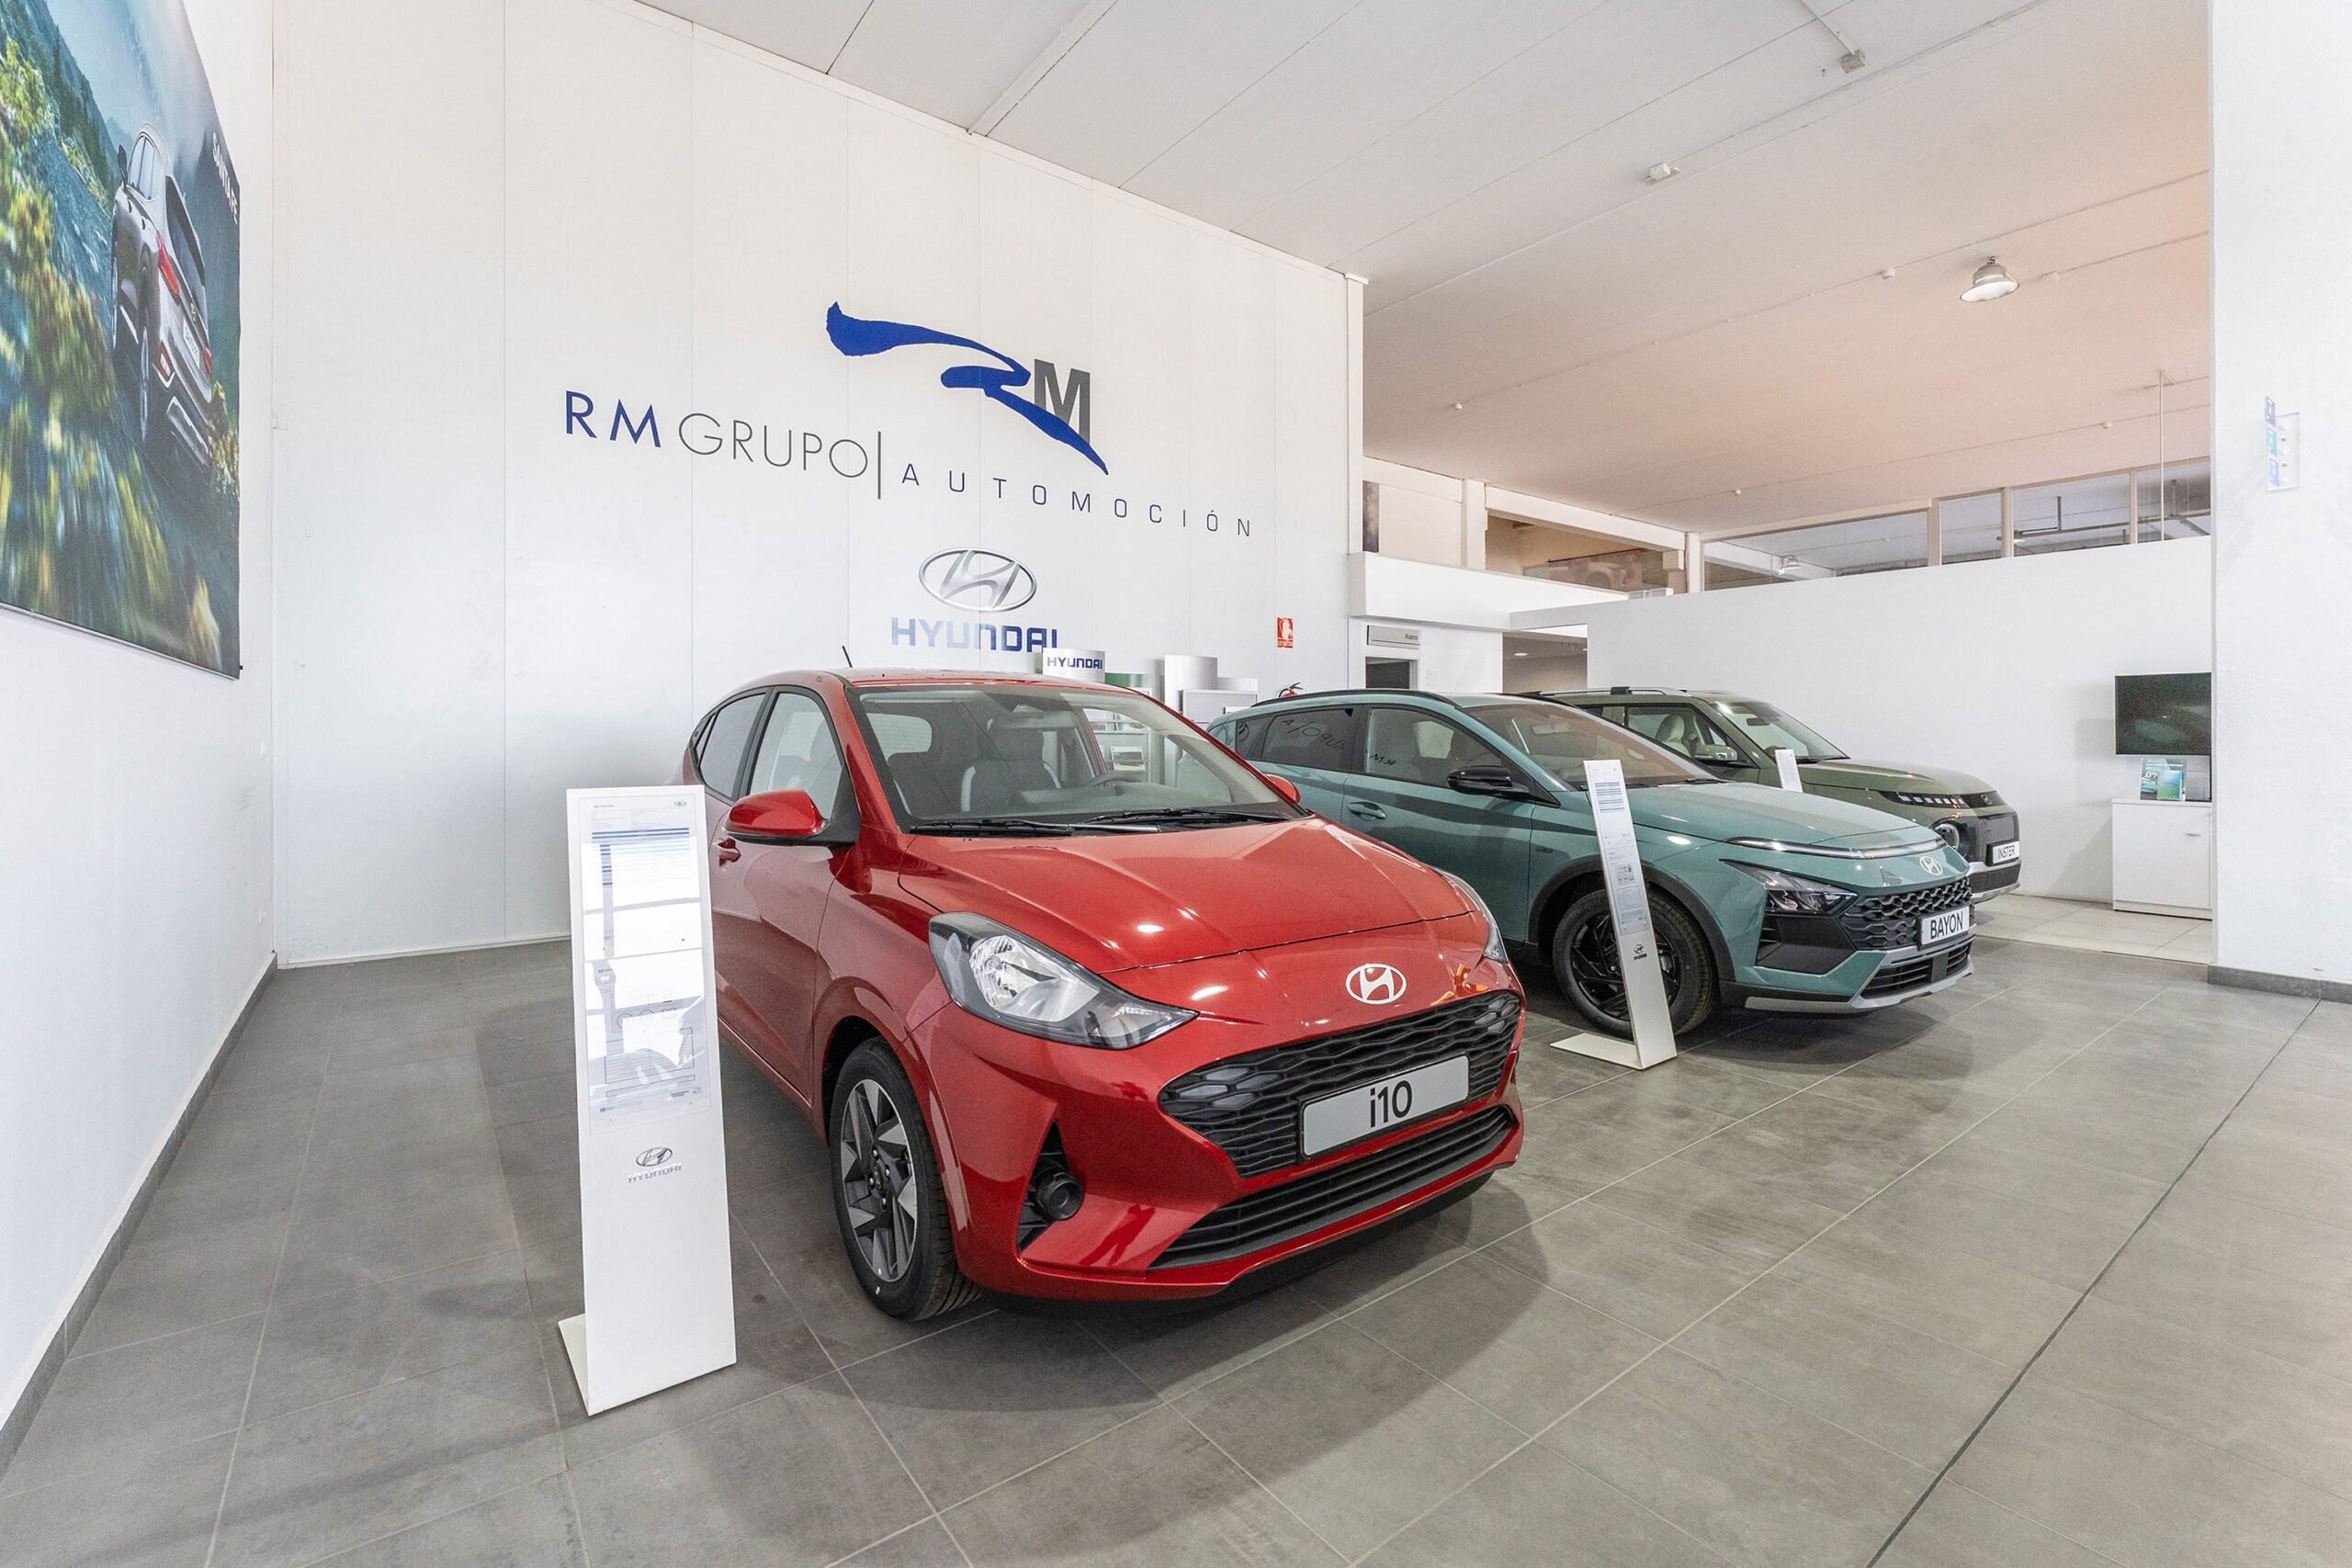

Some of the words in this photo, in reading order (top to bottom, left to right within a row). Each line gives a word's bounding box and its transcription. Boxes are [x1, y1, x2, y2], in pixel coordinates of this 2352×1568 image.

[565, 389, 662, 448] RM
[901, 463, 1250, 537] AUTOMOCIÓN
[891, 616, 1057, 653] HYUNDAI
[1046, 656, 1103, 670] HYUNDAI
[1930, 911, 1963, 939] BAYON
[1369, 1079, 1413, 1129] i10
[628, 1163, 682, 1183] HYUNDAI
